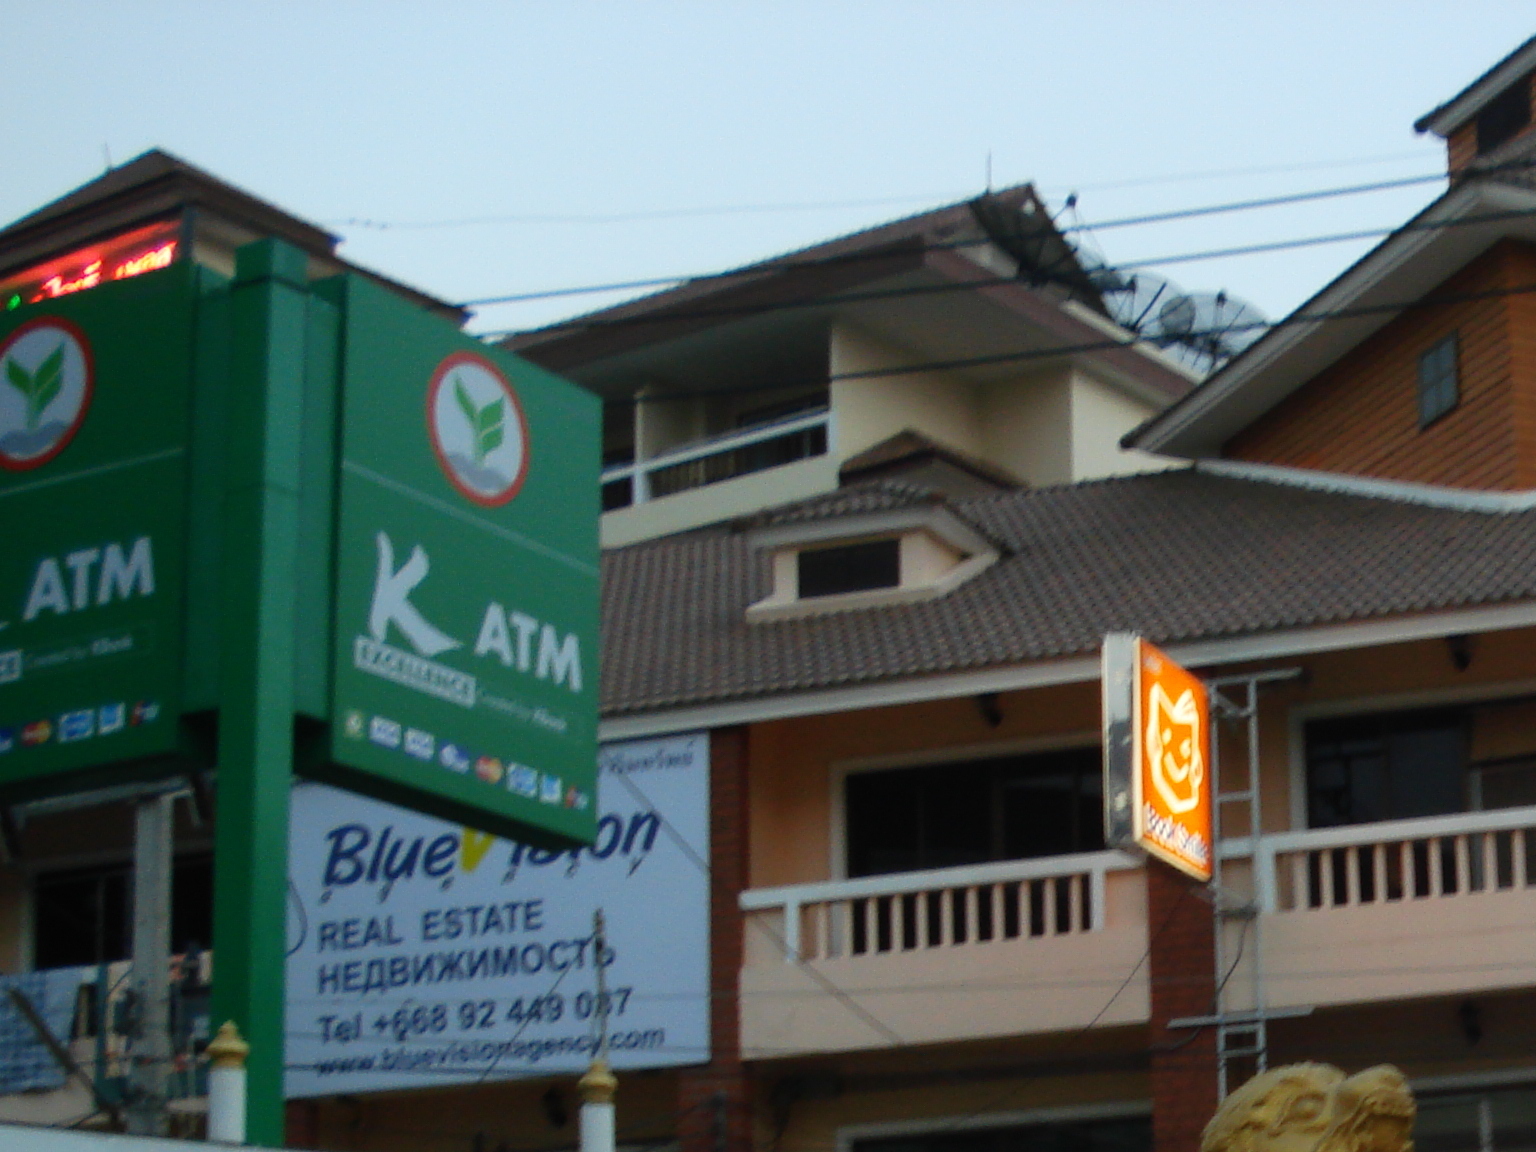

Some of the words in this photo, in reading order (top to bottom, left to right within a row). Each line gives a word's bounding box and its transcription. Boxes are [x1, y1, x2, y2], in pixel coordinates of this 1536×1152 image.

[22, 535, 155, 622] ATM
[370, 530, 465, 657] K
[473, 601, 583, 693] ATM
[323, 822, 459, 887] Blue
[317, 920, 404, 953] REAL
[421, 899, 545, 942] ESTATE
[317, 937, 617, 996] НЕДВИЖИМОСТЬ
[317, 1011, 364, 1044] Tel
